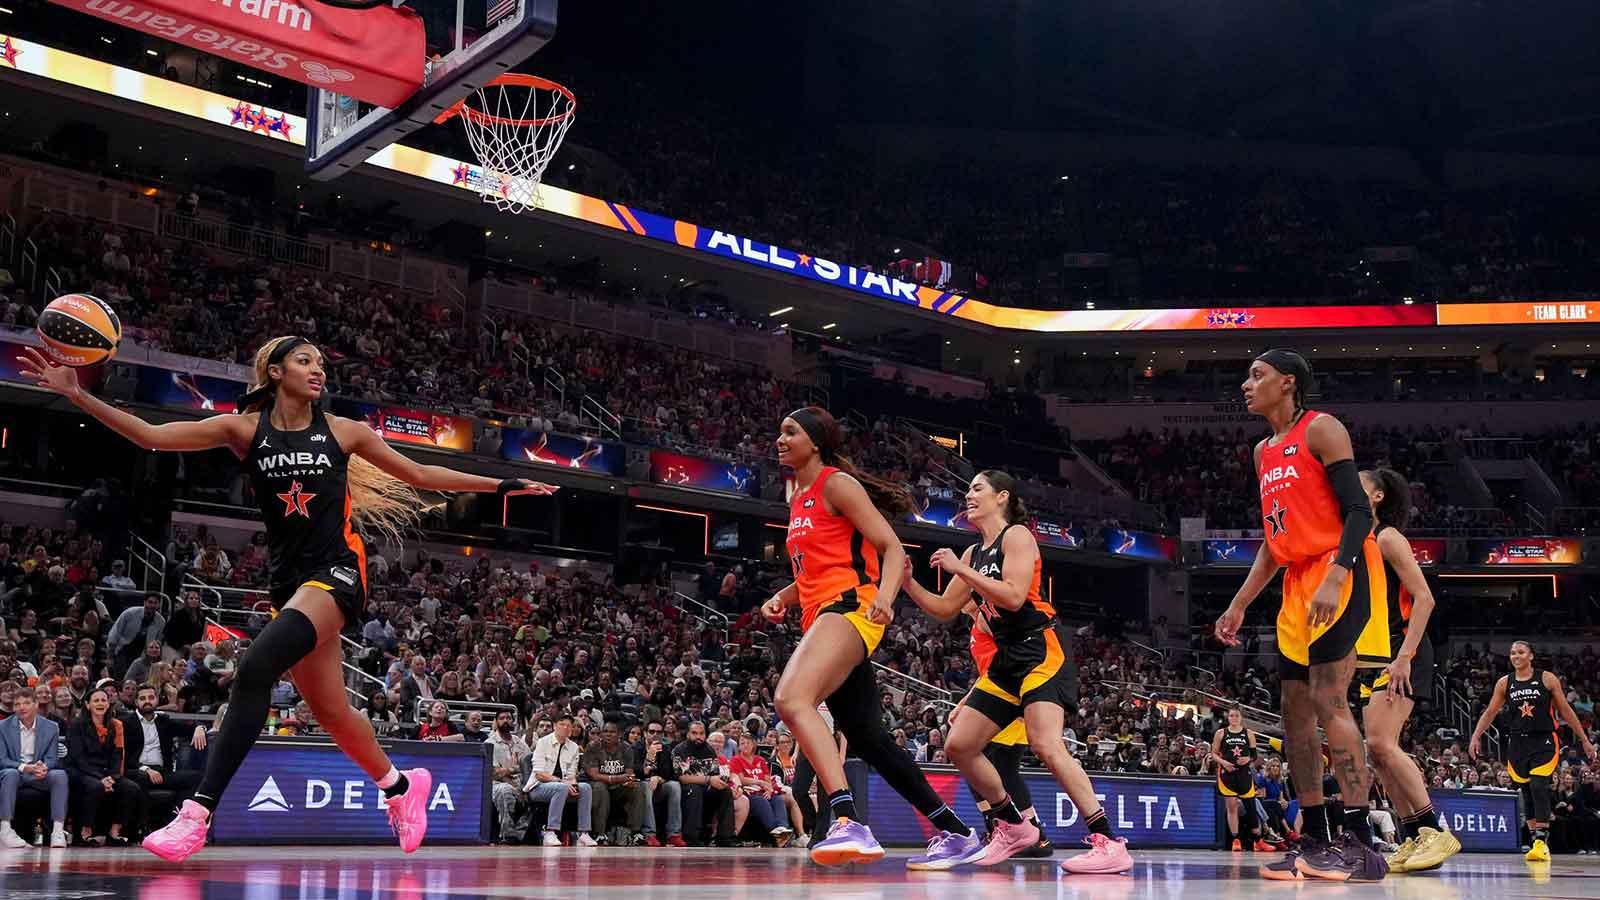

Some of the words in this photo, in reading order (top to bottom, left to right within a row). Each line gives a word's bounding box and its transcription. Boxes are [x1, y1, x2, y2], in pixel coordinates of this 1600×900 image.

[707, 230, 797, 269] ALL
[1533, 305, 1556, 320] TEAM
[385, 419, 403, 428] ALL
[406, 423, 429, 432] STAR
[310, 434, 327, 443] ally
[257, 452, 332, 471] WNBA
[1261, 465, 1300, 487] NBA
[1510, 688, 1541, 699] WNBA
[305, 779, 455, 812] DELA
[1454, 813, 1508, 833] DELTA
